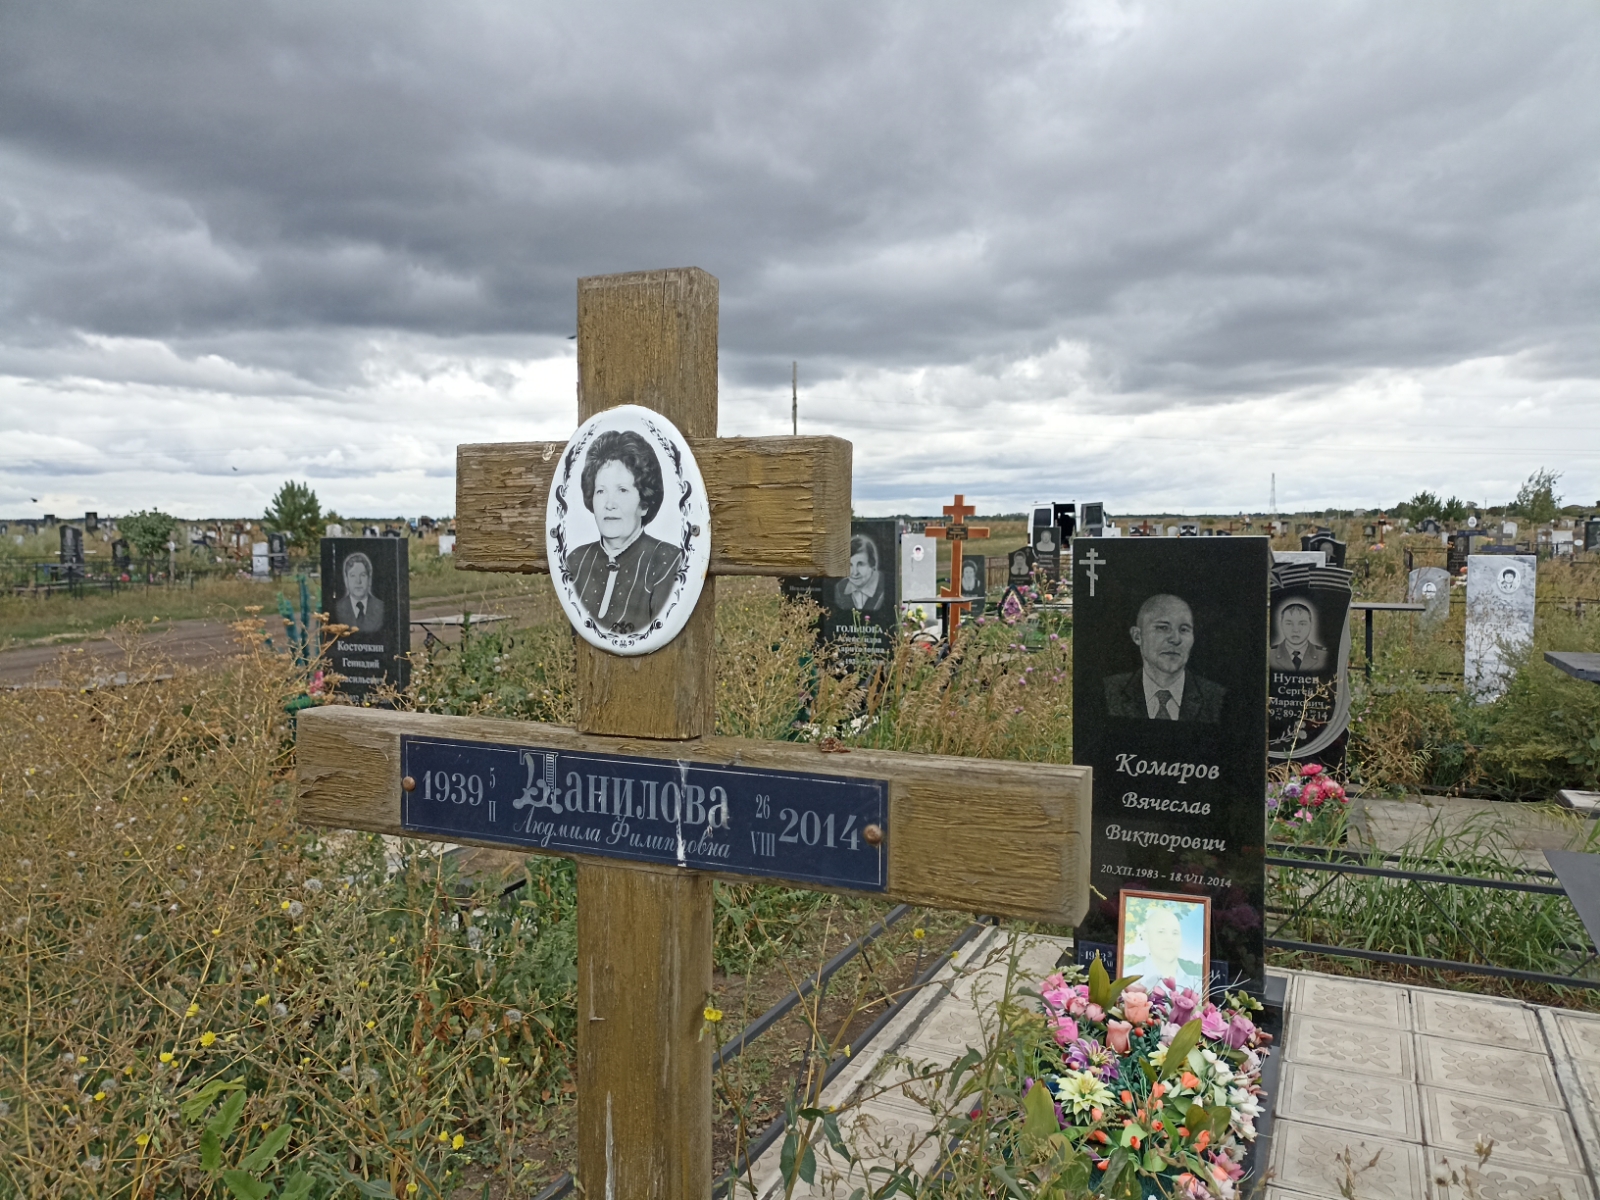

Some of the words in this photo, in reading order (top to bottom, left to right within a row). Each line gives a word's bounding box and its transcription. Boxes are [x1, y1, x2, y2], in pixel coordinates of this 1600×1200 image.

[337, 641, 385, 652] Косточкин
[1277, 686, 1314, 696] Сергей
[489, 767, 496, 789] 5
[1115, 753, 1220, 784] Комаров
[422, 770, 484, 806] 1939
[512, 748, 731, 830] Данилова
[755, 793, 771, 820] 26
[1122, 791, 1211, 816] Вячеслав
[514, 806, 602, 848] Людмила
[778, 807, 861, 851] 2014
[1105, 823, 1227, 853] Викторович
[750, 830, 776, 857] VIII
[1100, 863, 1159, 880] 20.XII.1983
